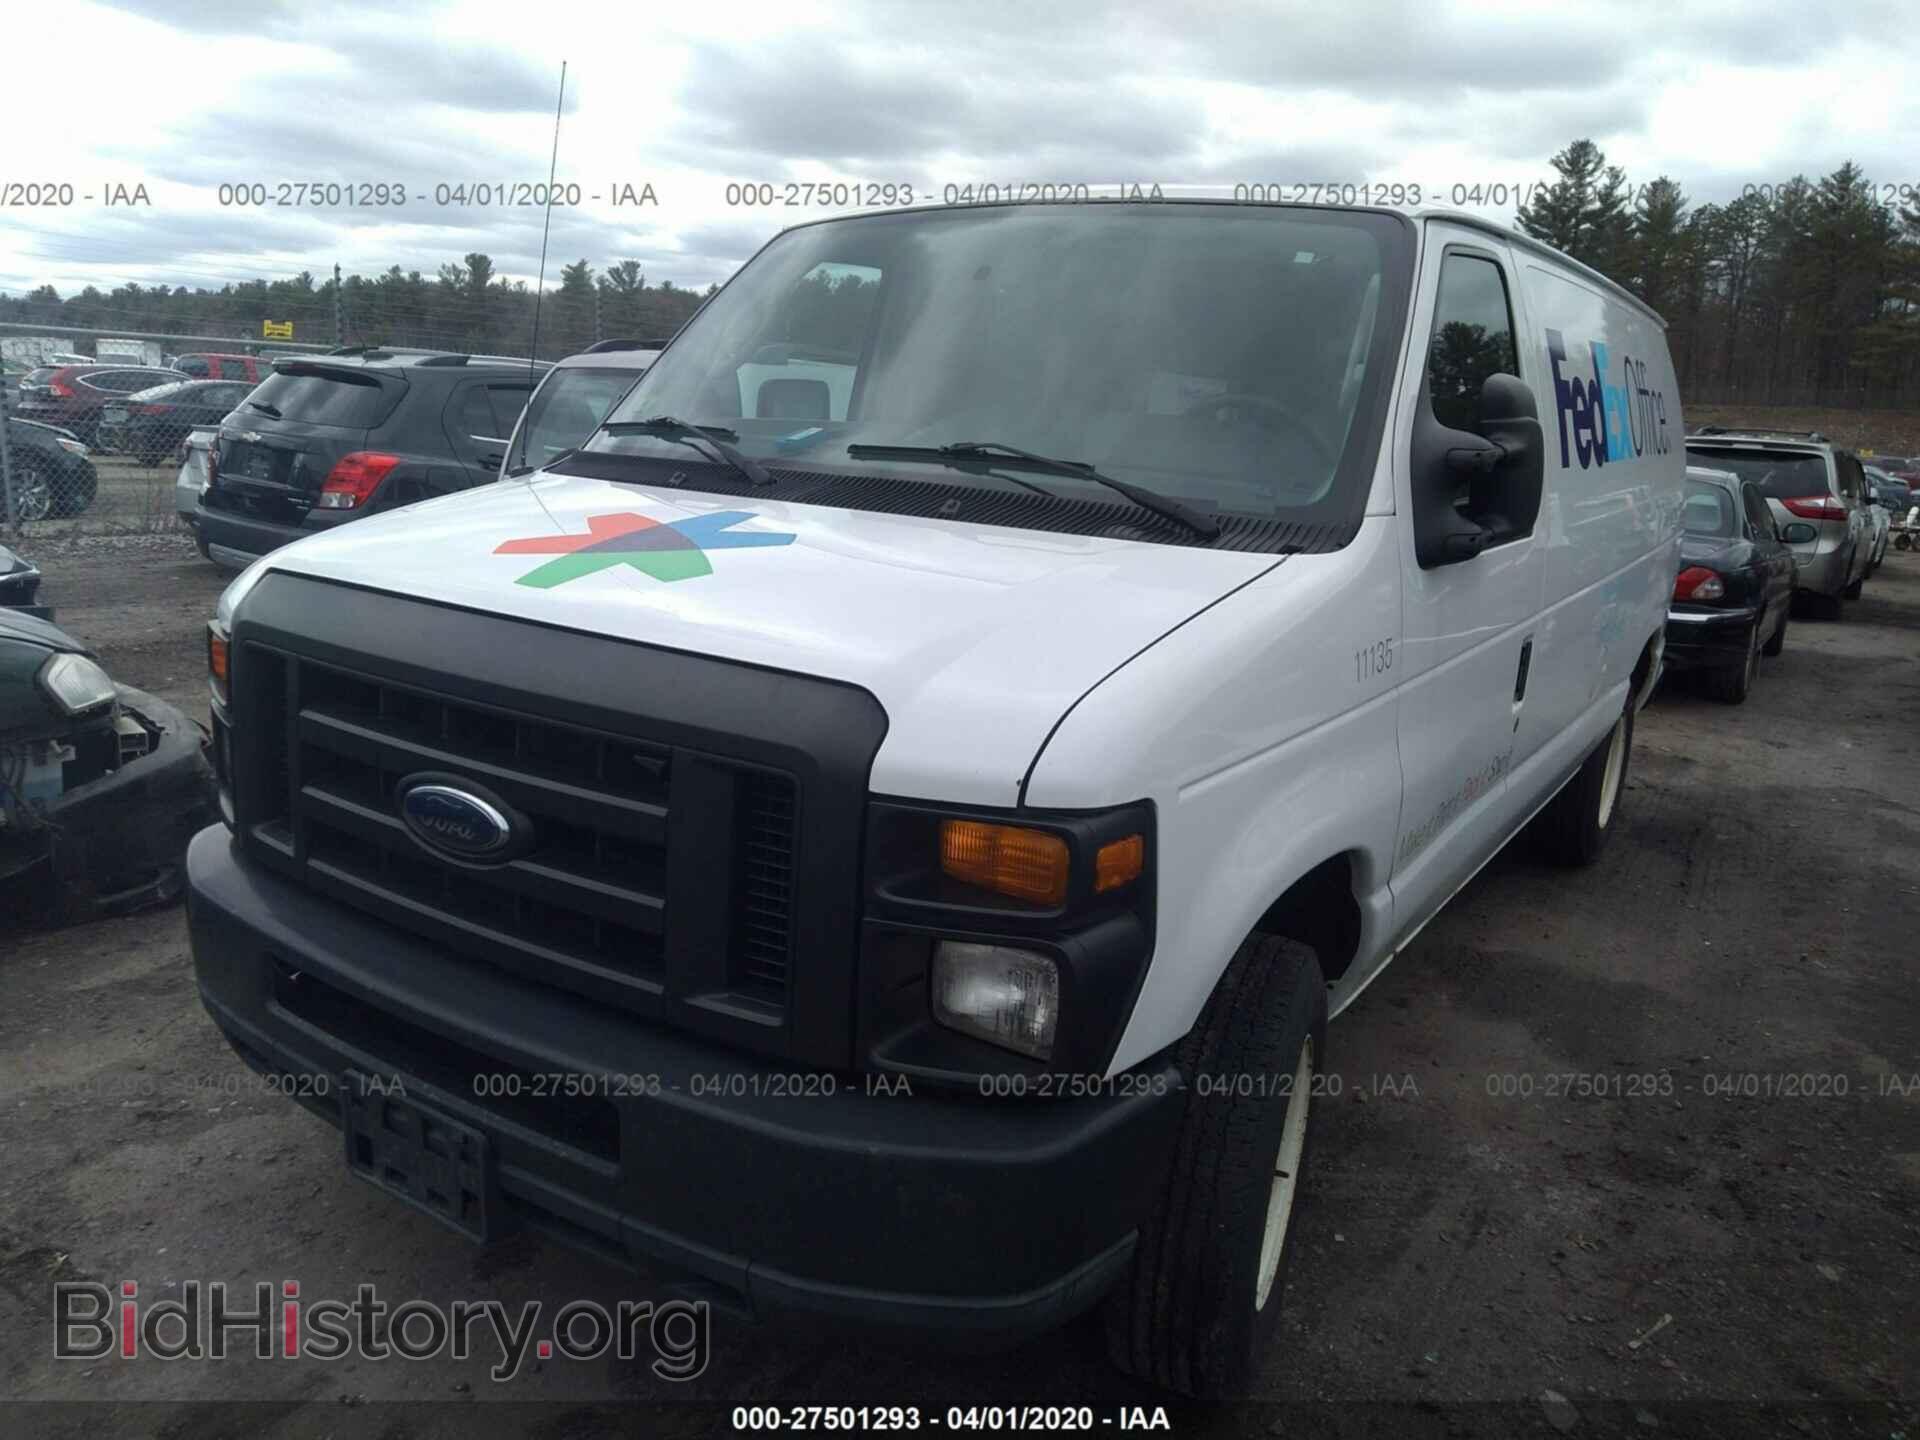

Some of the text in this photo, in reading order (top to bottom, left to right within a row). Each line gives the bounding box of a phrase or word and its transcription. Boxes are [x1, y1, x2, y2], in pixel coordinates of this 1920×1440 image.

[1545, 328, 1672, 470] FedEx Office
[1354, 637, 1393, 684] 11135
